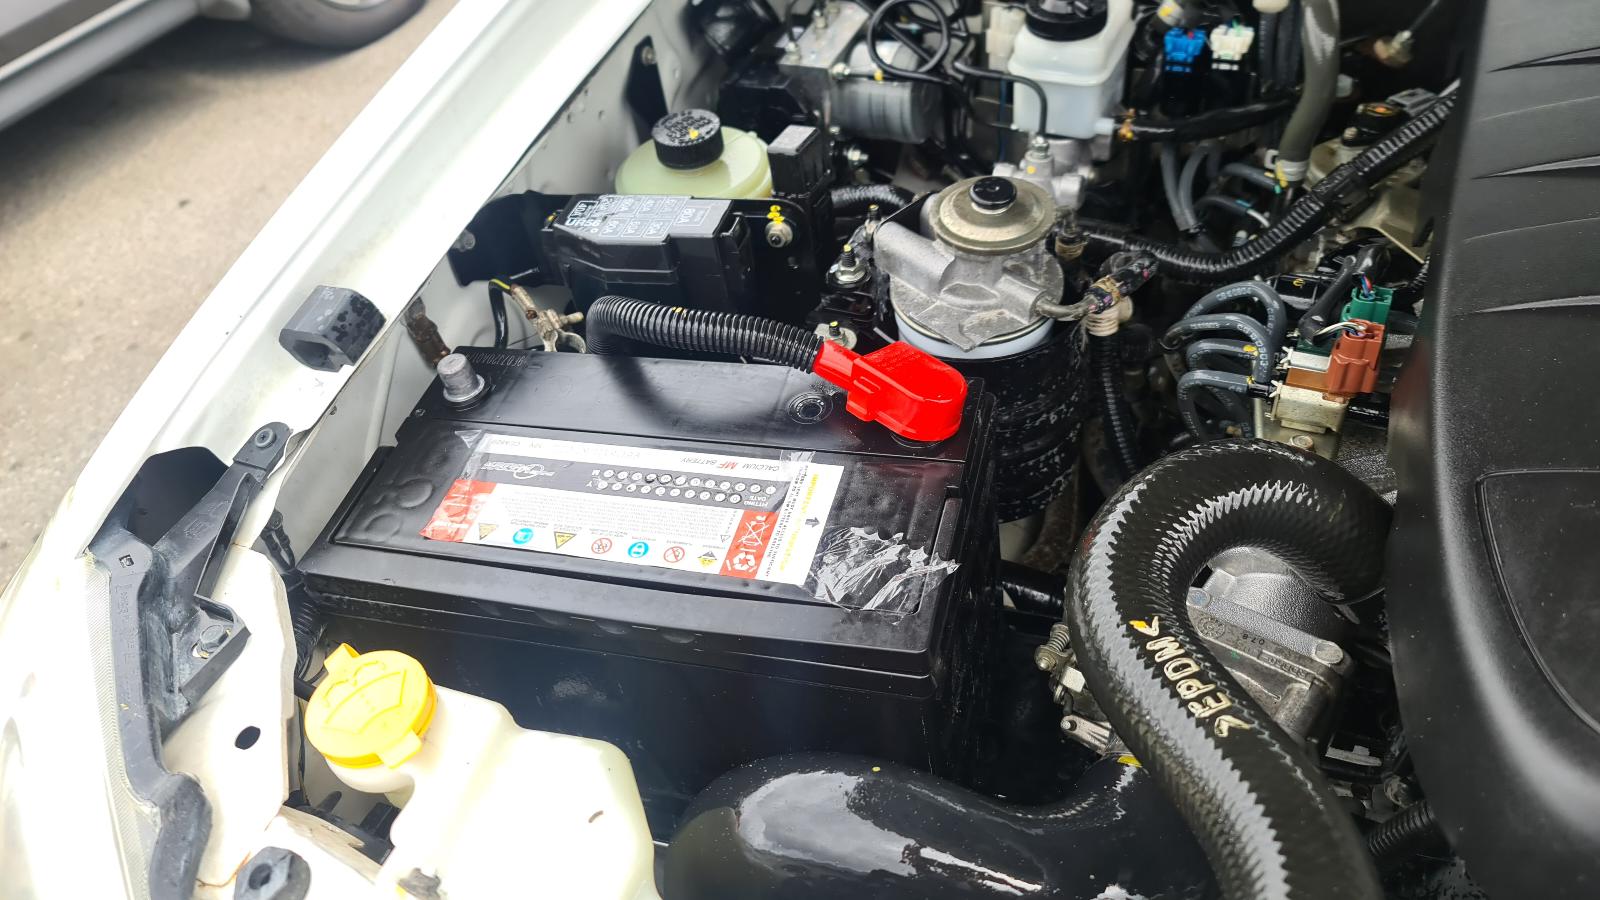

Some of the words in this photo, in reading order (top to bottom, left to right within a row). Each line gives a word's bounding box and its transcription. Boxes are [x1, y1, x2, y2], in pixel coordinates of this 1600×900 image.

[680, 458, 718, 466] BATTERY
[719, 460, 739, 470] MF
[742, 462, 780, 472] CALCIUM
